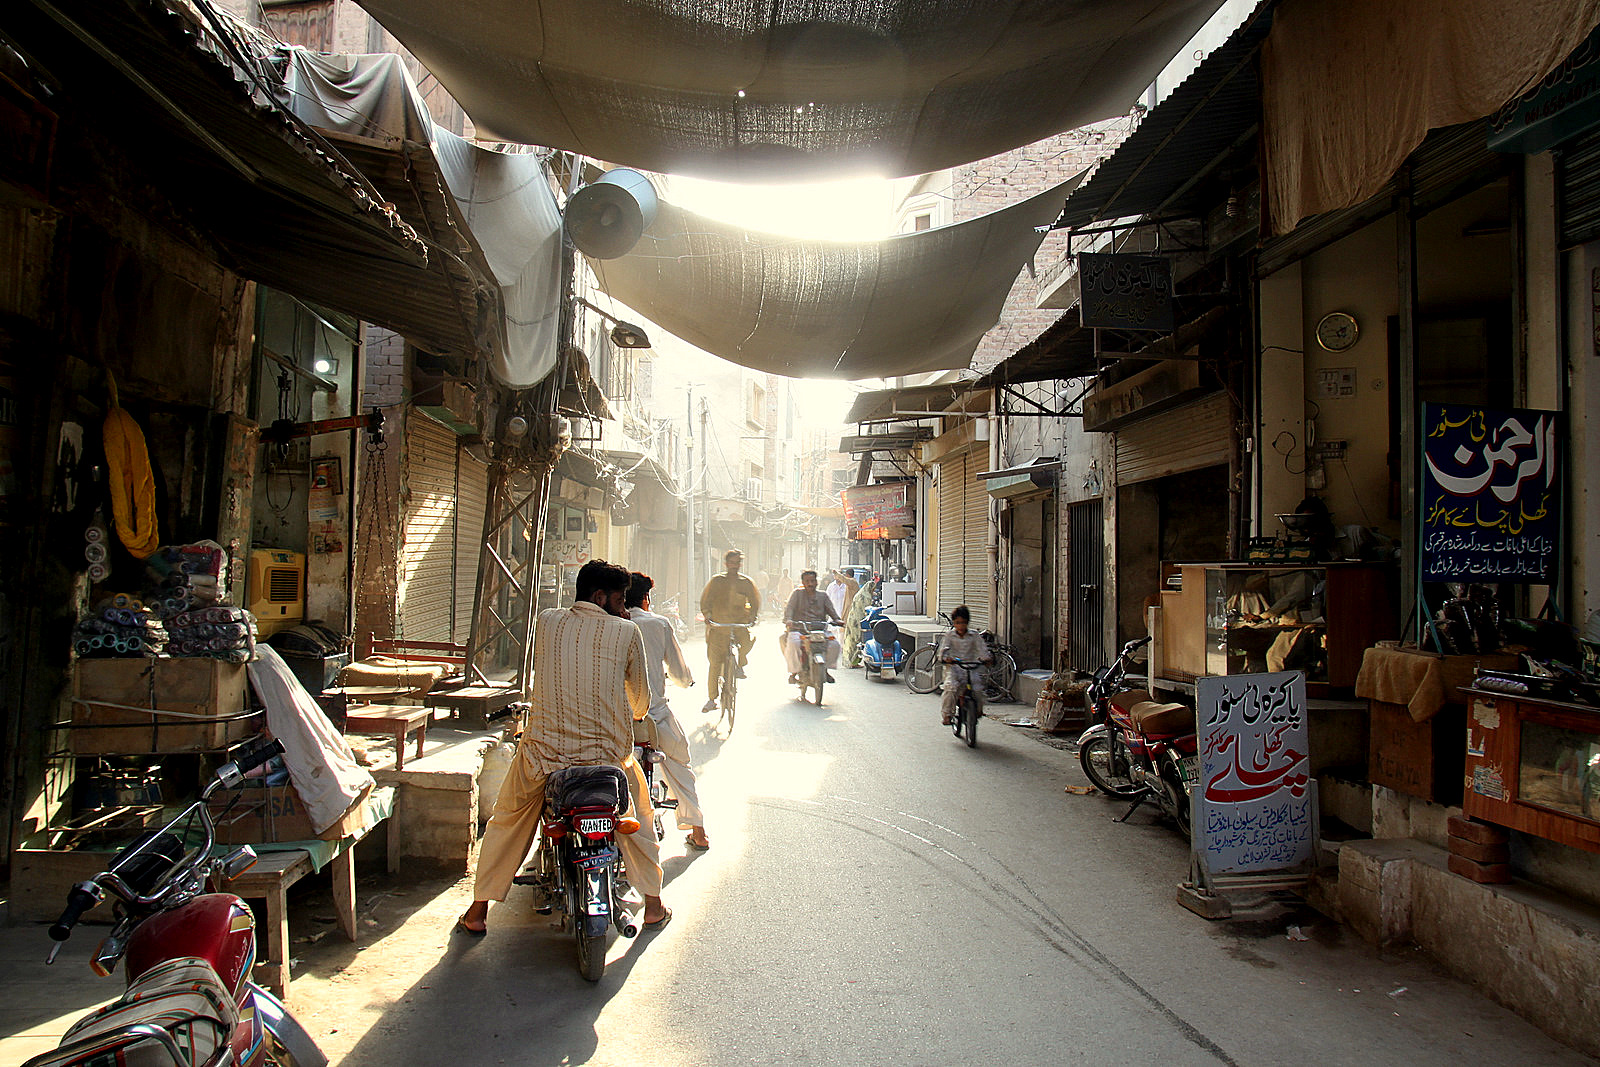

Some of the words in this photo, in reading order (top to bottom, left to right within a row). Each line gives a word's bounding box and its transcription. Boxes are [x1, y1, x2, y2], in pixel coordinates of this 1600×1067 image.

[1118, 261, 1169, 304] پاکیزہ
[1428, 407, 1472, 438] سٹور
[1470, 408, 1487, 442] ٹی
[1425, 494, 1447, 528] مرکز
[1444, 507, 1458, 526] کا
[1451, 499, 1510, 534] چائے
[1424, 532, 1436, 552] کی
[1480, 543, 1492, 552] سے
[1529, 535, 1544, 552] کے
[1206, 683, 1247, 727] سٹور
[1242, 682, 1261, 726] ٹی
[1262, 674, 1301, 731] پاکیزہ
[580, 819, 612, 833] WANTED
[1298, 826, 1309, 841] کے
